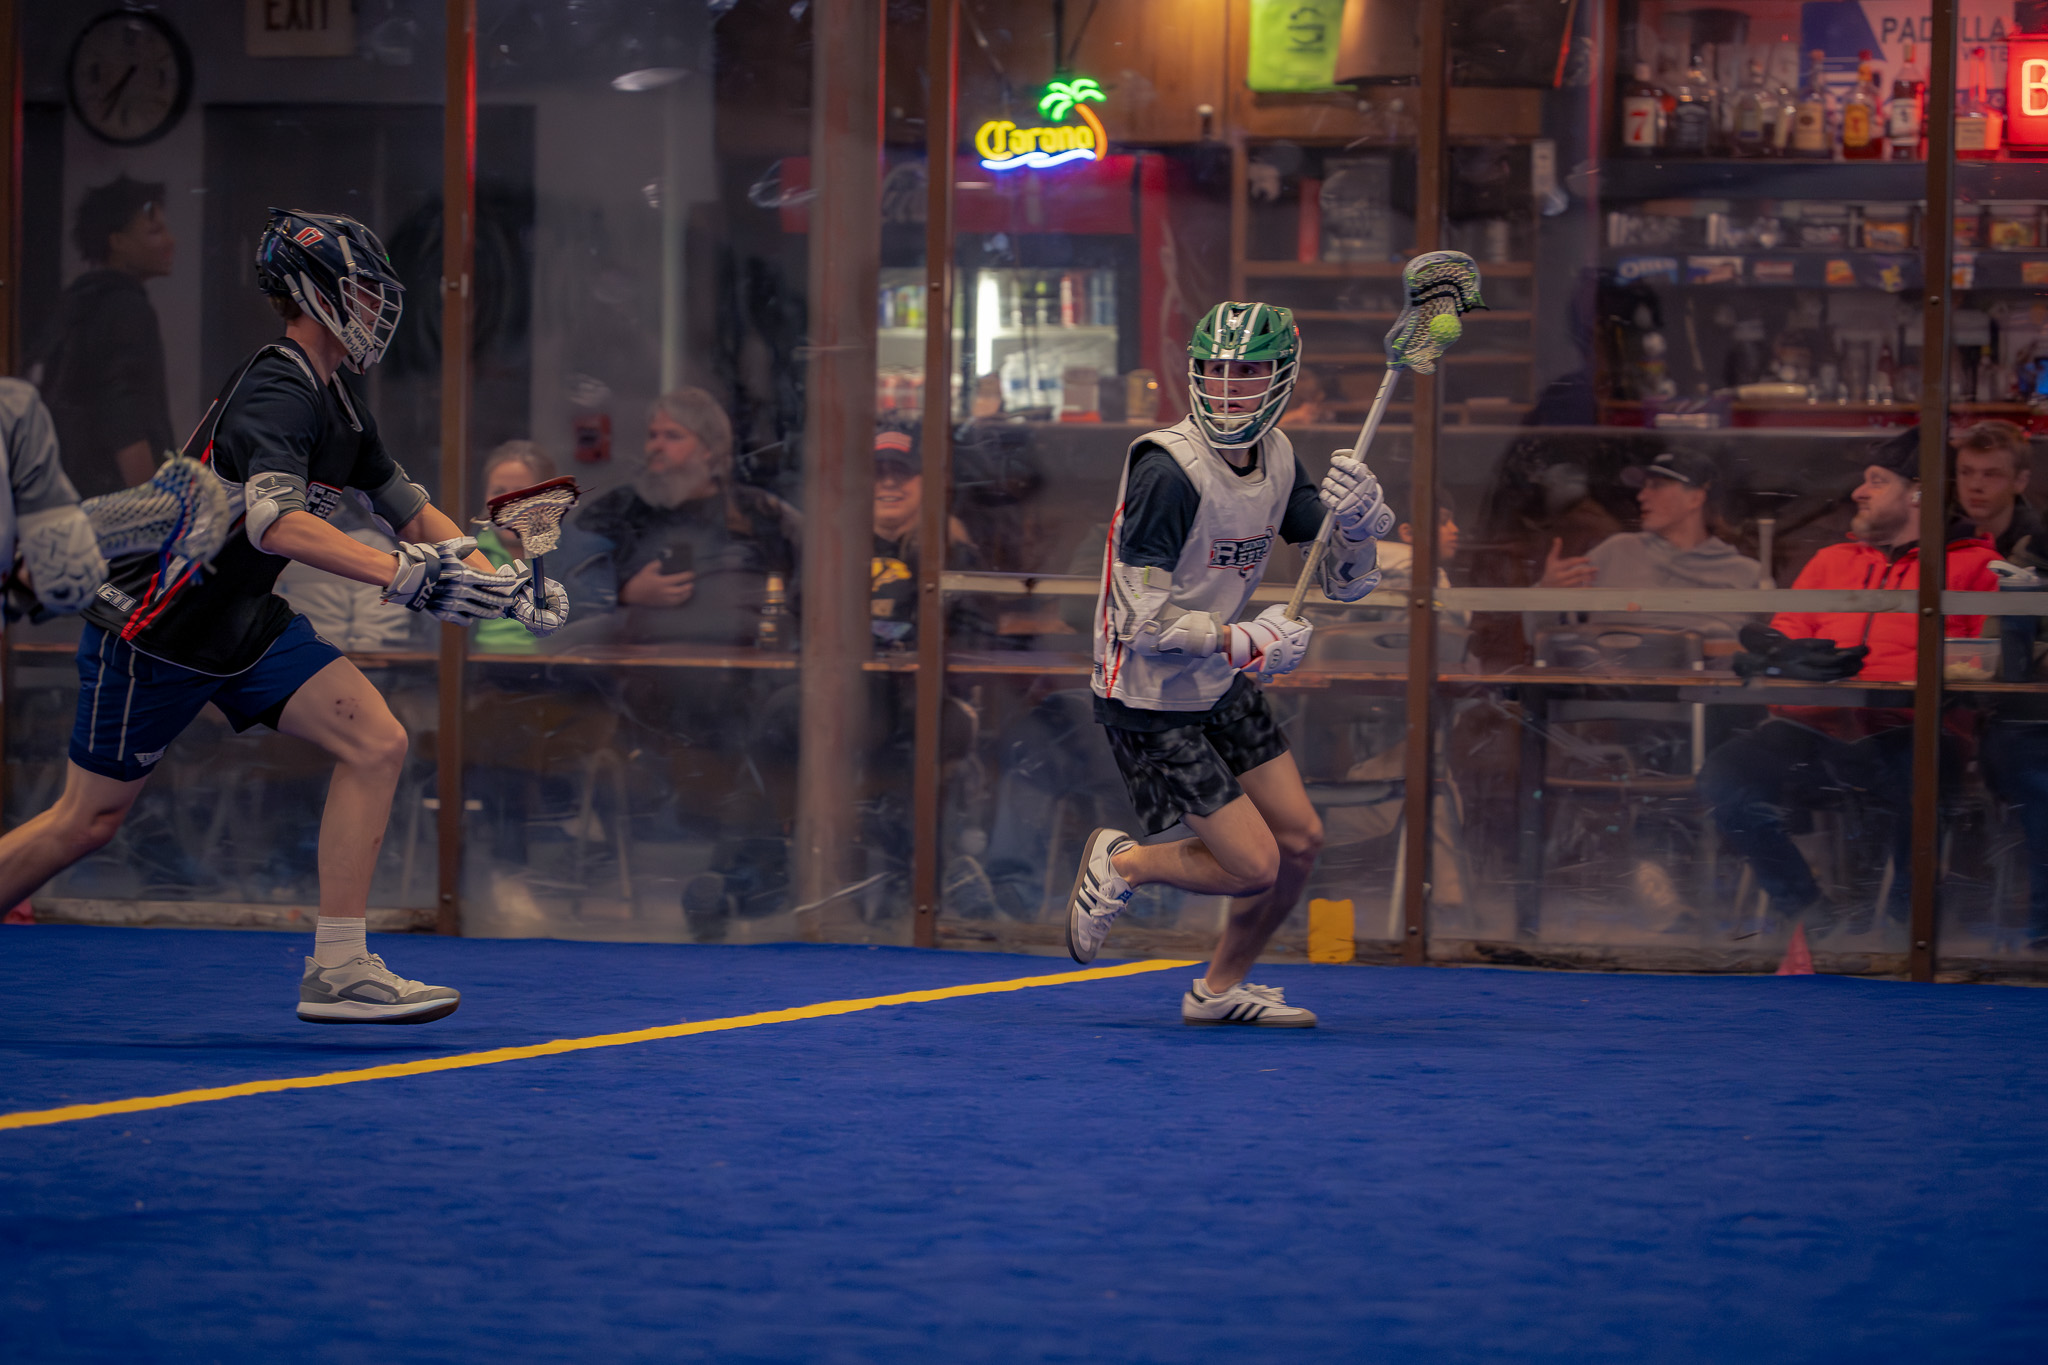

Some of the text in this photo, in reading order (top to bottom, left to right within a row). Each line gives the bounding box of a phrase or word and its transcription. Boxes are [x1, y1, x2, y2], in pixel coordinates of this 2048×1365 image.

[1882, 17, 2007, 43] PADLLA
[1629, 109, 1649, 142] 7
[413, 576, 438, 609] STX
